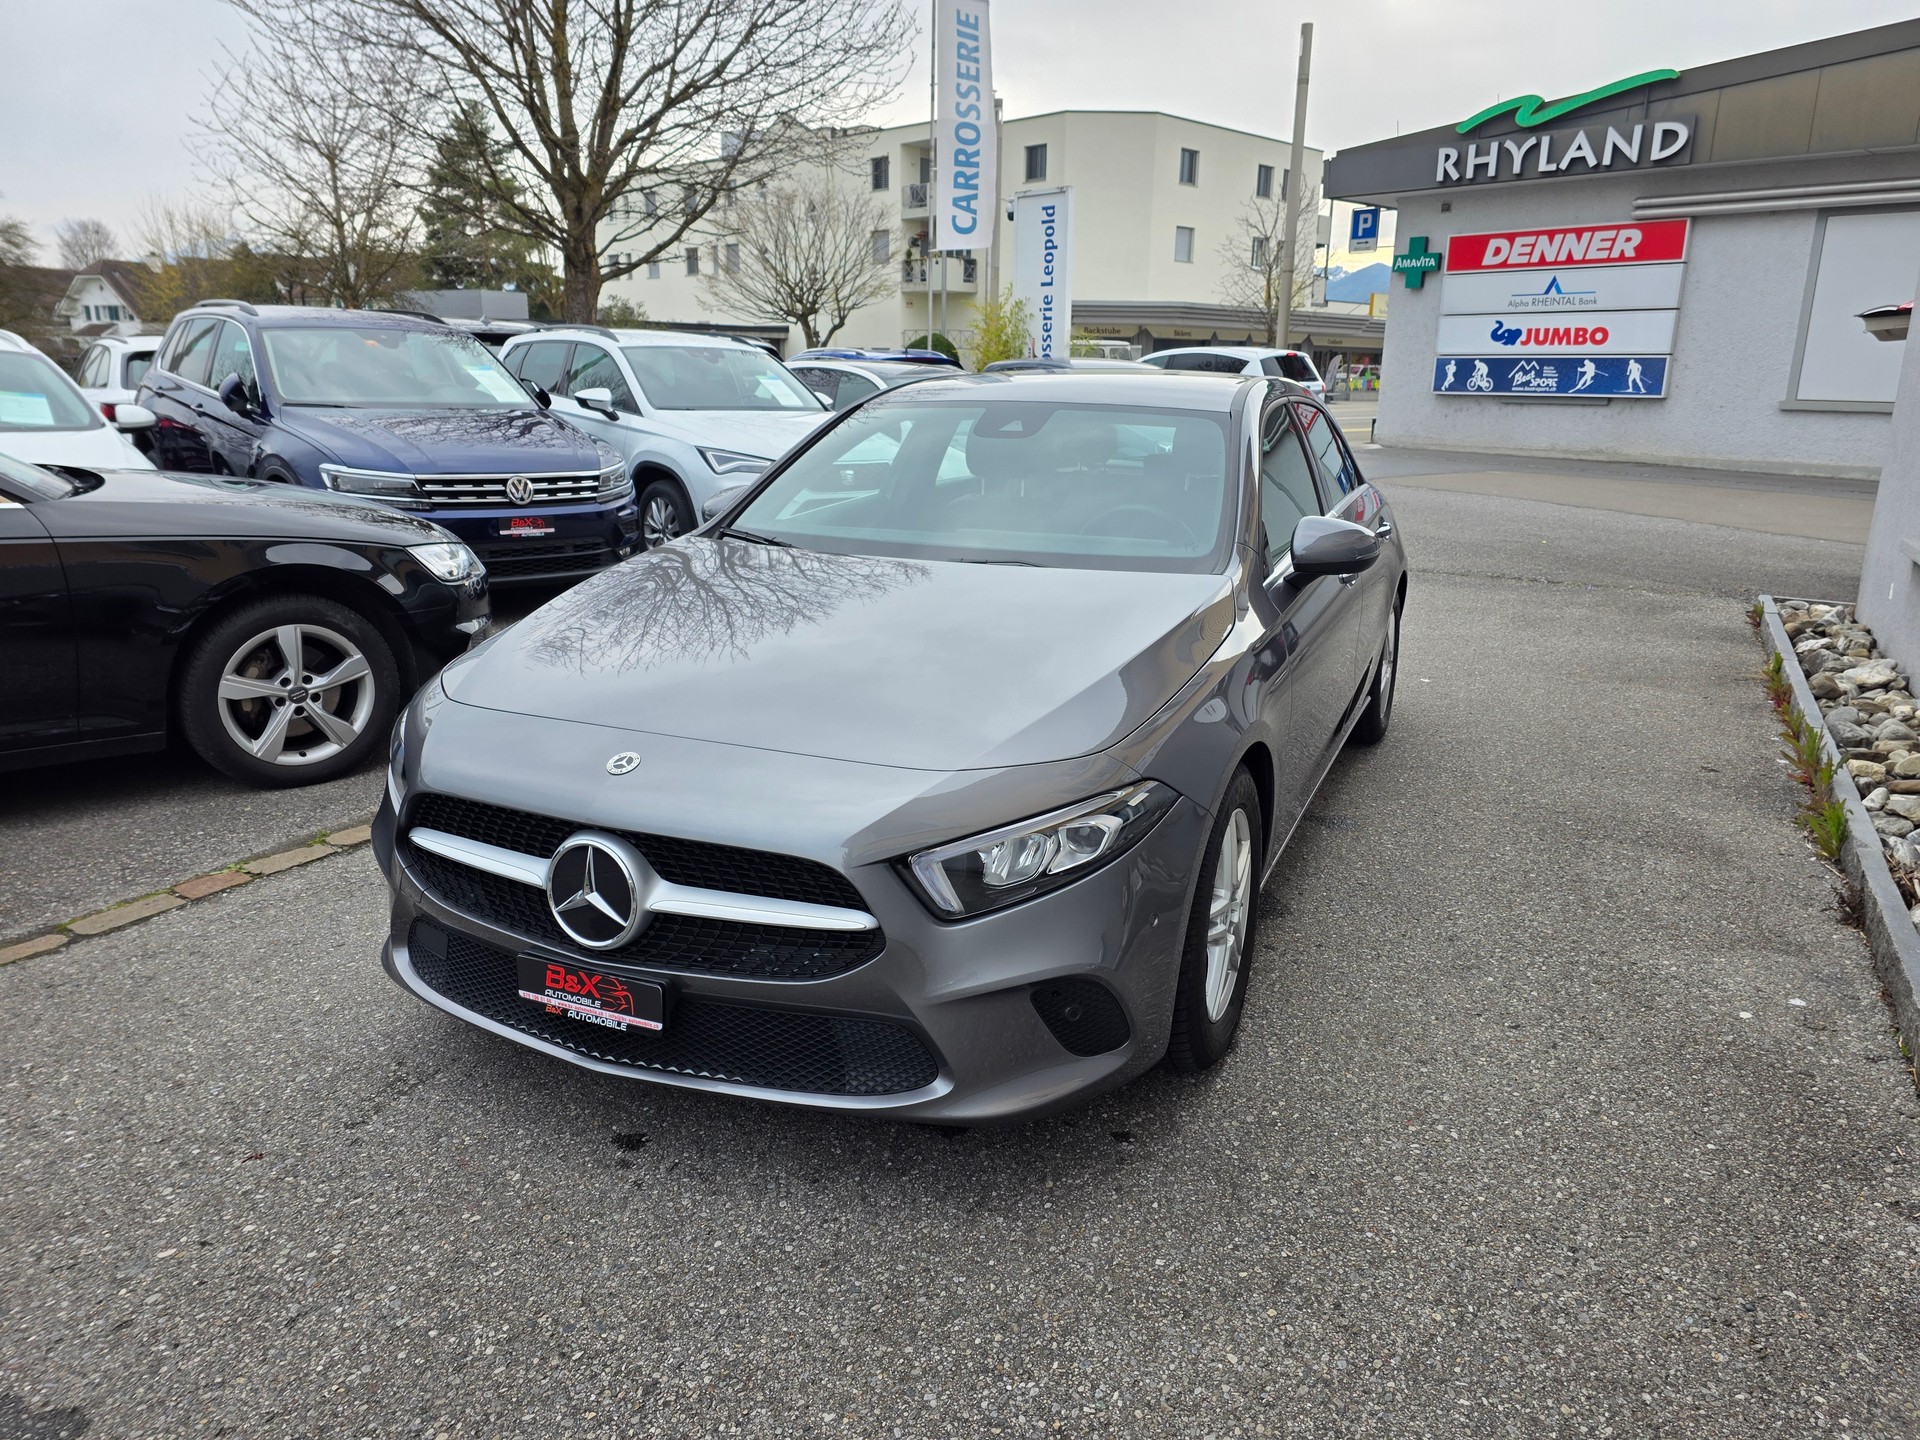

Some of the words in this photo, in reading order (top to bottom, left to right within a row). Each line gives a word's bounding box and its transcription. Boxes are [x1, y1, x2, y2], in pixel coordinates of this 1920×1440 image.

[951, 9, 981, 235] CARROSSERIE
[1435, 121, 1689, 182] RHYLAND
[1357, 213, 1373, 237] P
[1040, 204, 1058, 287] Leopold
[1481, 228, 1642, 266] DENNER
[1507, 300, 1529, 309] Alpha
[1531, 297, 1576, 307] RHEINTAL
[1578, 297, 1597, 306] Bank
[1520, 326, 1609, 346] JUMBO
[1512, 370, 1536, 386] Beat
[1529, 378, 1558, 387] SPORT
[545, 964, 602, 999] B&X
[544, 988, 602, 1009] AUTOMOBILE
[567, 1010, 628, 1031] AUTOMOBILE
